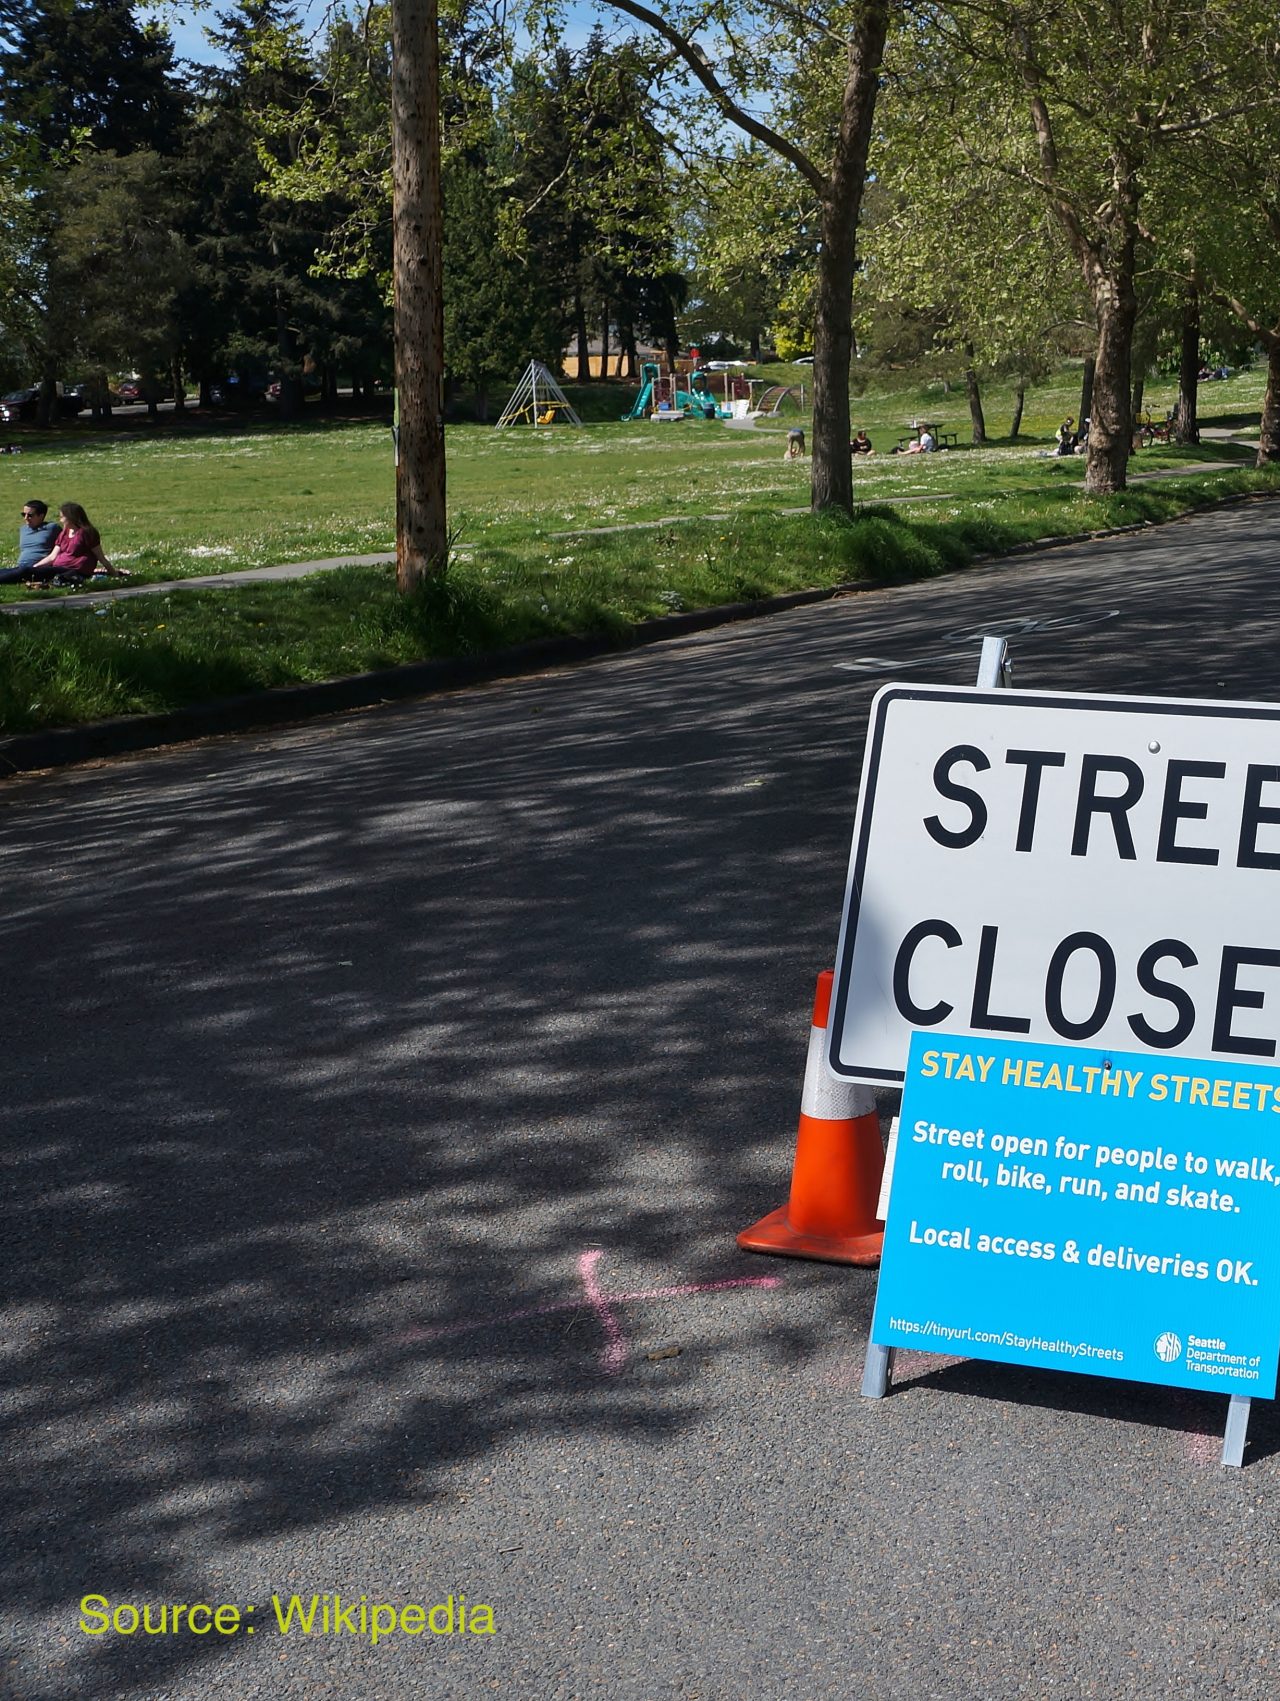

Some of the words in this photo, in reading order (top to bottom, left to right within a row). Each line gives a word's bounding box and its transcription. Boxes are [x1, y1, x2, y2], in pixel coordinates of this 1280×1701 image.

[921, 1051, 995, 1082] STAY
[1002, 1059, 1143, 1097] HEALTHY
[913, 1121, 985, 1149] Street
[991, 1135, 1047, 1157] open
[1056, 1136, 1090, 1162] for
[1096, 1146, 1177, 1172] people
[1185, 1152, 1208, 1174] to
[1215, 1158, 1280, 1186] walk,
[942, 1160, 988, 1187] roll,
[997, 1164, 1051, 1194] bike,
[1060, 1176, 1107, 1201] run,
[1115, 1182, 1160, 1203] and
[1166, 1185, 1240, 1213] skate.
[910, 1221, 970, 1249] Local
[977, 1235, 1055, 1260] access
[1063, 1240, 1079, 1263] &
[1088, 1244, 1208, 1279] deliveries
[1217, 1259, 1258, 1285] OK.
[890, 1318, 1123, 1360] https://tinyurl.com/StayHealthyStreets
[1186, 1347, 1247, 1366] Department
[1248, 1356, 1261, 1367] of
[1187, 1335, 1226, 1350] Seattle
[1185, 1360, 1260, 1379] Transportation
